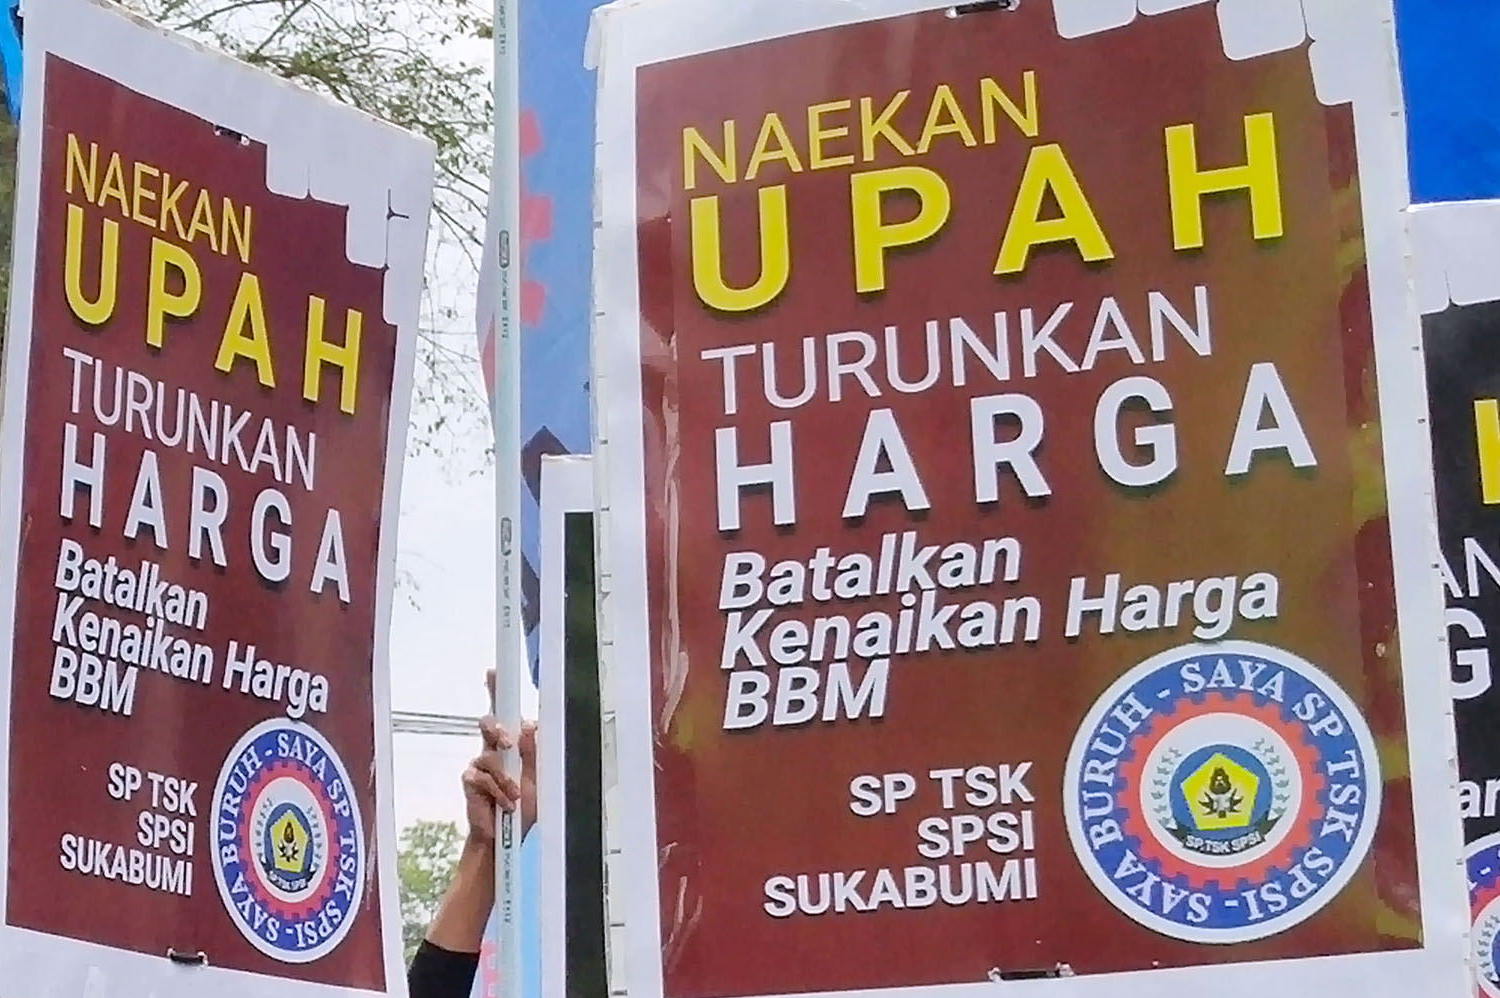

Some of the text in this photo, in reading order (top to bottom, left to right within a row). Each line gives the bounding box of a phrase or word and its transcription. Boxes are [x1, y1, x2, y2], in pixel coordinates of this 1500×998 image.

[682, 70, 1039, 190] NAEKAN
[64, 133, 251, 263] NAEKAN
[690, 112, 1283, 312] UPAH
[64, 203, 362, 415] UPAH
[700, 285, 1214, 415] TURUNKAN
[63, 347, 316, 491] TURUNKAN
[713, 361, 1317, 531] HARGA
[60, 423, 350, 603] HARGA
[55, 538, 208, 630] Batalkan
[718, 532, 1021, 610] Batalkan
[52, 592, 329, 719] Kenaikan Harga
[719, 569, 1280, 670] Kenaikan Harga
[49, 647, 139, 716] BBM
[721, 661, 889, 729] BBM
[1180, 658, 1285, 703] SAYA
[1292, 692, 1343, 737] SP
[108, 762, 198, 817] SP TSK
[277, 732, 328, 781] SAYA
[849, 762, 1034, 816] SP TSK
[1081, 691, 1154, 850] BURUH
[219, 745, 263, 867] BURUH
[327, 779, 350, 819] SP
[1321, 749, 1361, 842] TSK
[59, 833, 193, 896] SUKABUMI
[137, 811, 195, 857] SPSI
[335, 829, 357, 901] TSK
[917, 810, 1034, 859] SPSI
[231, 871, 280, 942] SAYA
[763, 858, 1037, 917] SUKABUMI
[1113, 849, 1212, 923] SAYA
